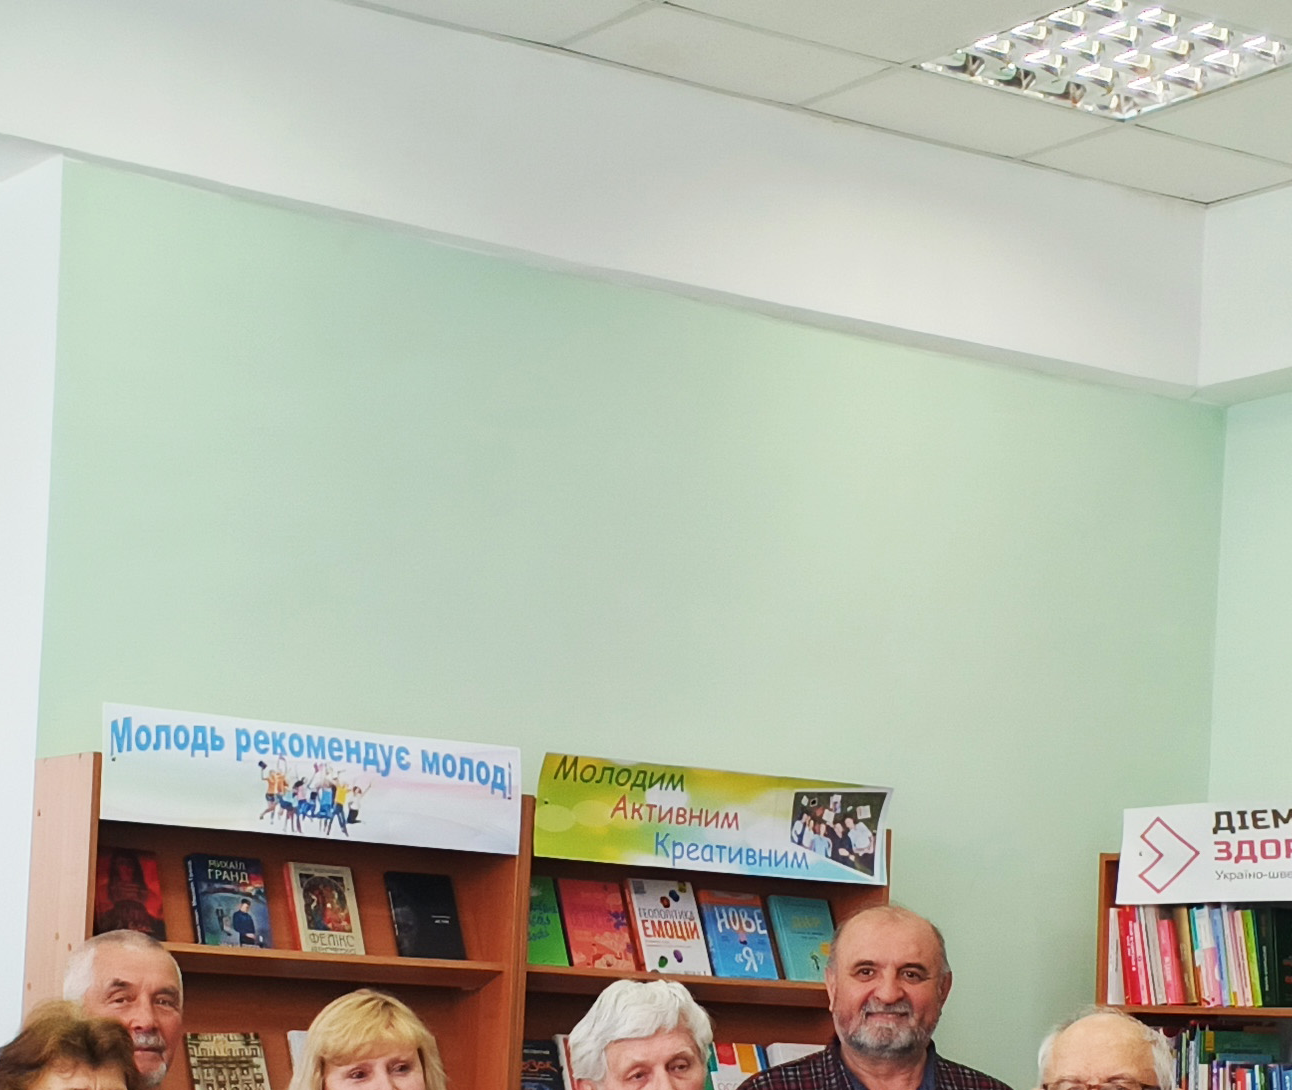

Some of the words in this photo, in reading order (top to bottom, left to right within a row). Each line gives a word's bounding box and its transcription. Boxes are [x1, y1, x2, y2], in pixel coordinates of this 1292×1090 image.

[110, 717, 225, 757] Молодь
[235, 726, 411, 776] рекомендує
[421, 749, 512, 800] молоді
[554, 755, 685, 792] Молодим
[610, 794, 739, 831] Активним
[654, 832, 809, 870] Креативним
[640, 917, 701, 941] ЕМОЦІЙ
[714, 906, 768, 935] НОВЕ
